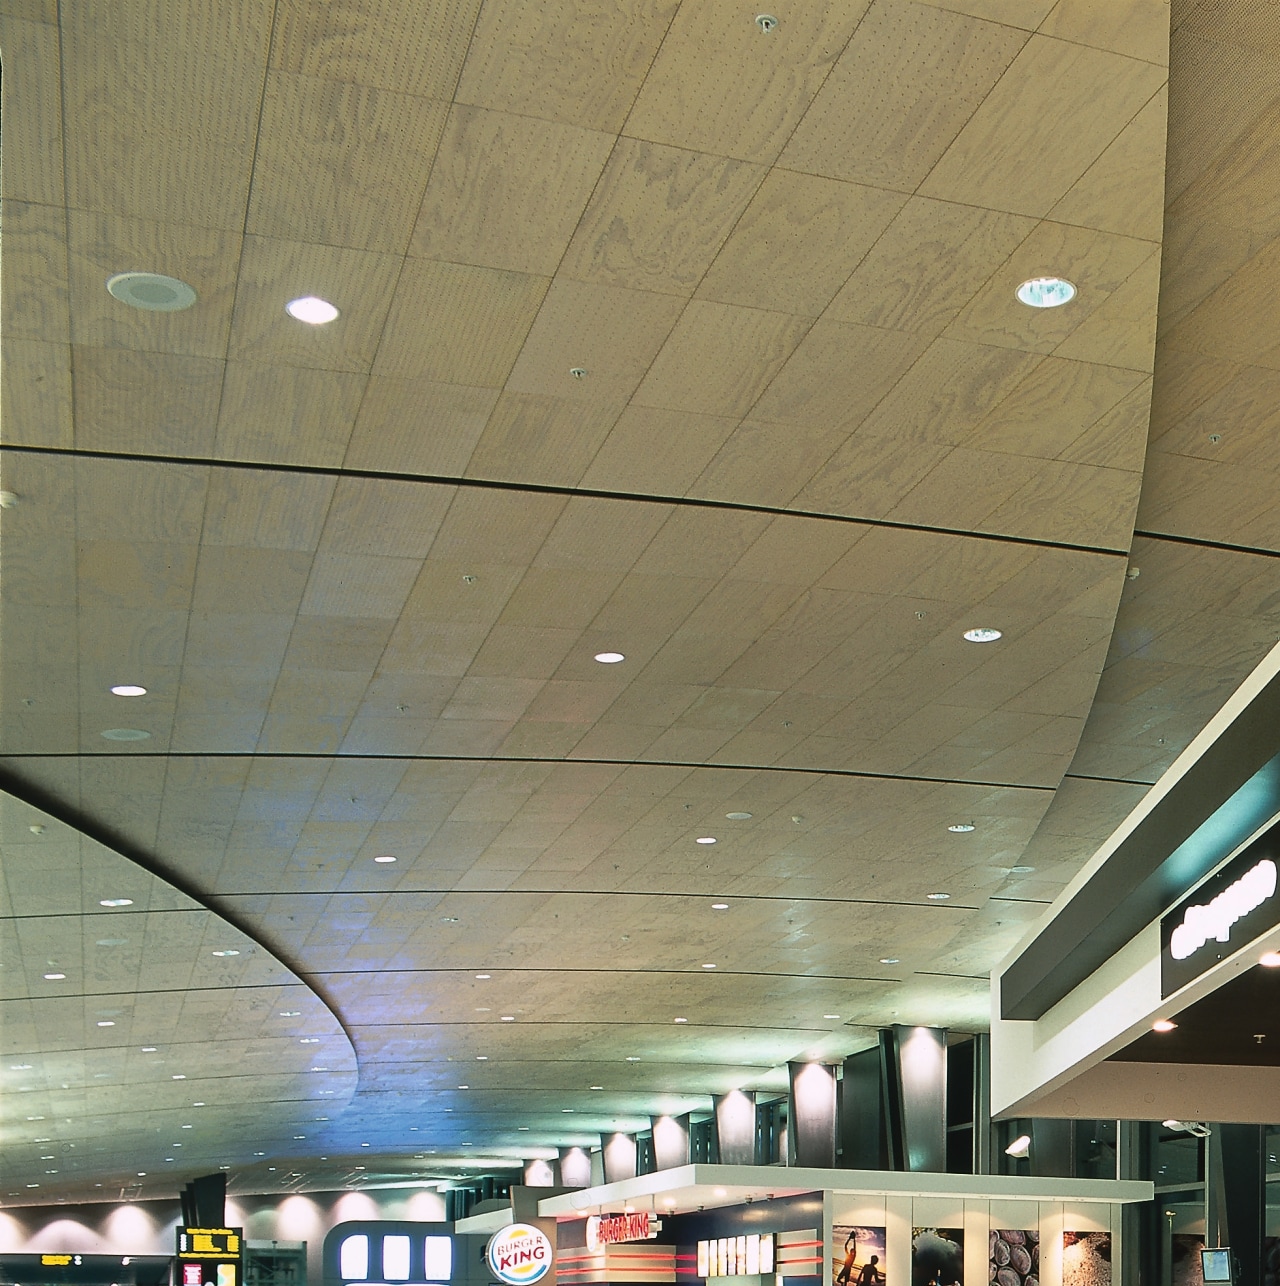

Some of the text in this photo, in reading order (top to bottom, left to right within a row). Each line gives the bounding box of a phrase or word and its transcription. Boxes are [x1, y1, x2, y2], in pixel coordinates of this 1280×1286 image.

[599, 1212, 649, 1243] BURGER KING
[497, 1236, 543, 1256] BURGER
[500, 1246, 545, 1270] KING
